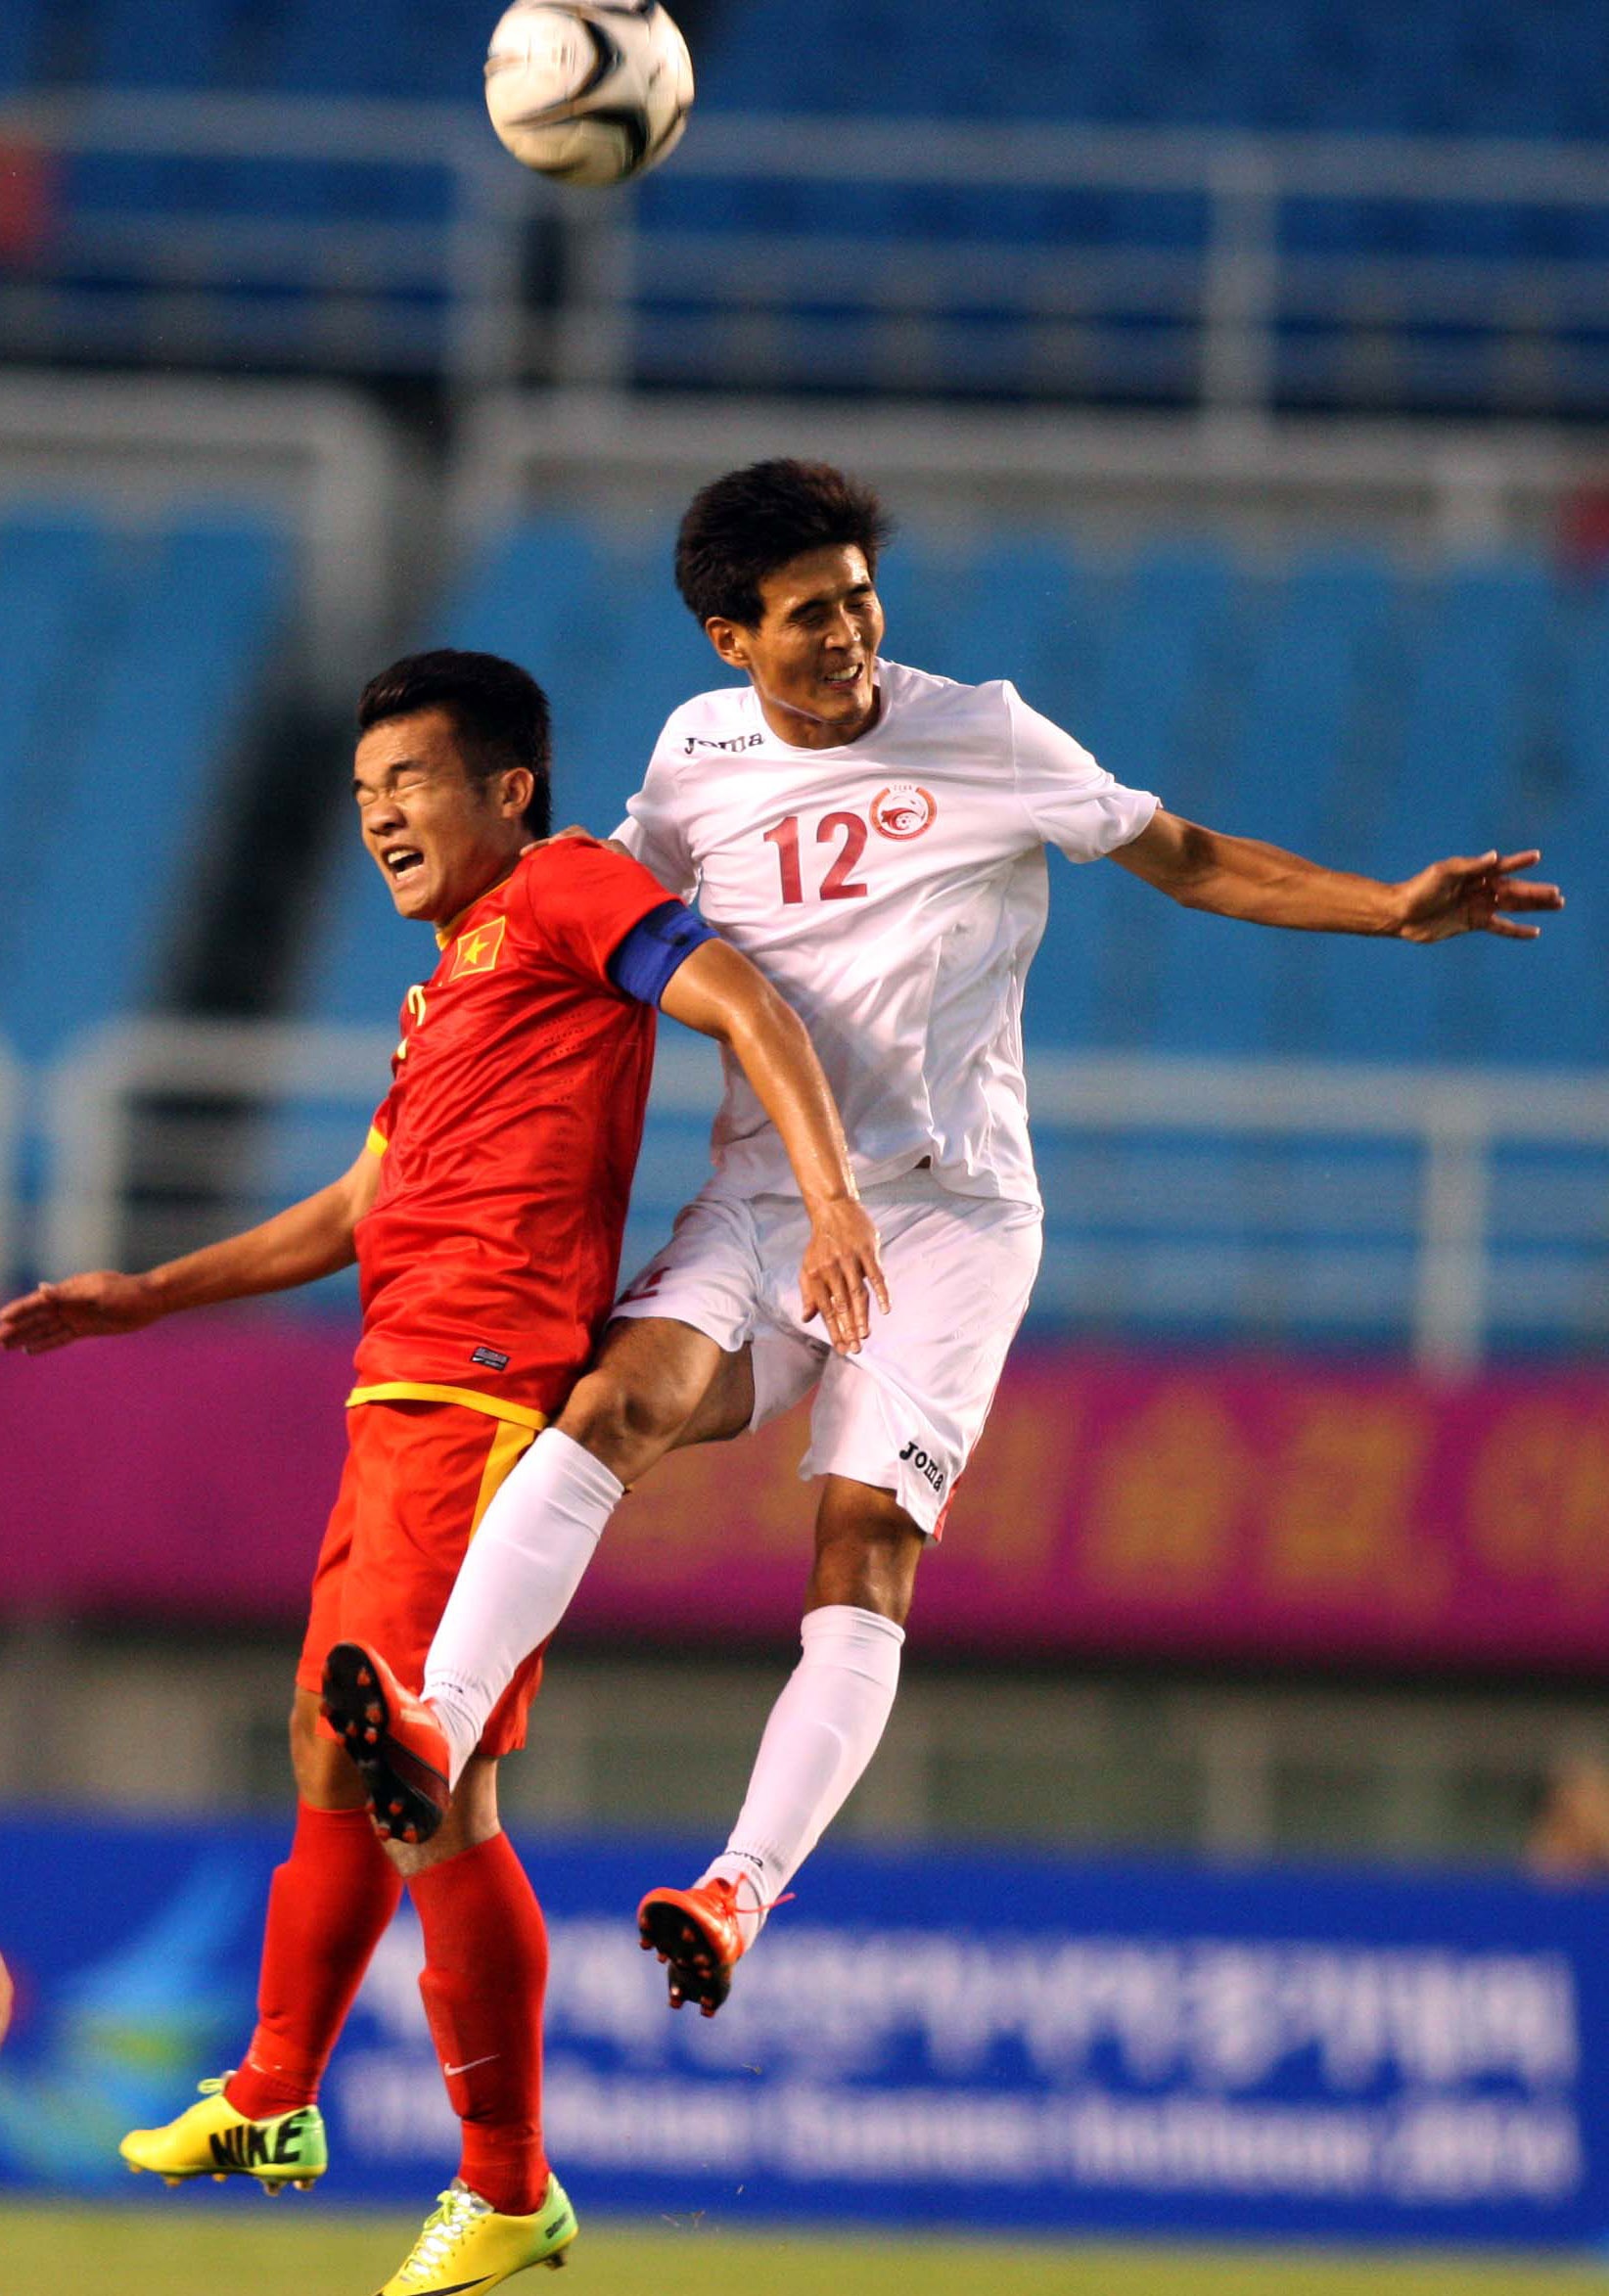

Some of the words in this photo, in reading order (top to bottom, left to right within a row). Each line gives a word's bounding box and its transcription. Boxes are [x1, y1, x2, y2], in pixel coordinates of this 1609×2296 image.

[763, 811, 868, 904] 12
[898, 1441, 943, 1492] Joma
[208, 2109, 309, 2169] NIKE
